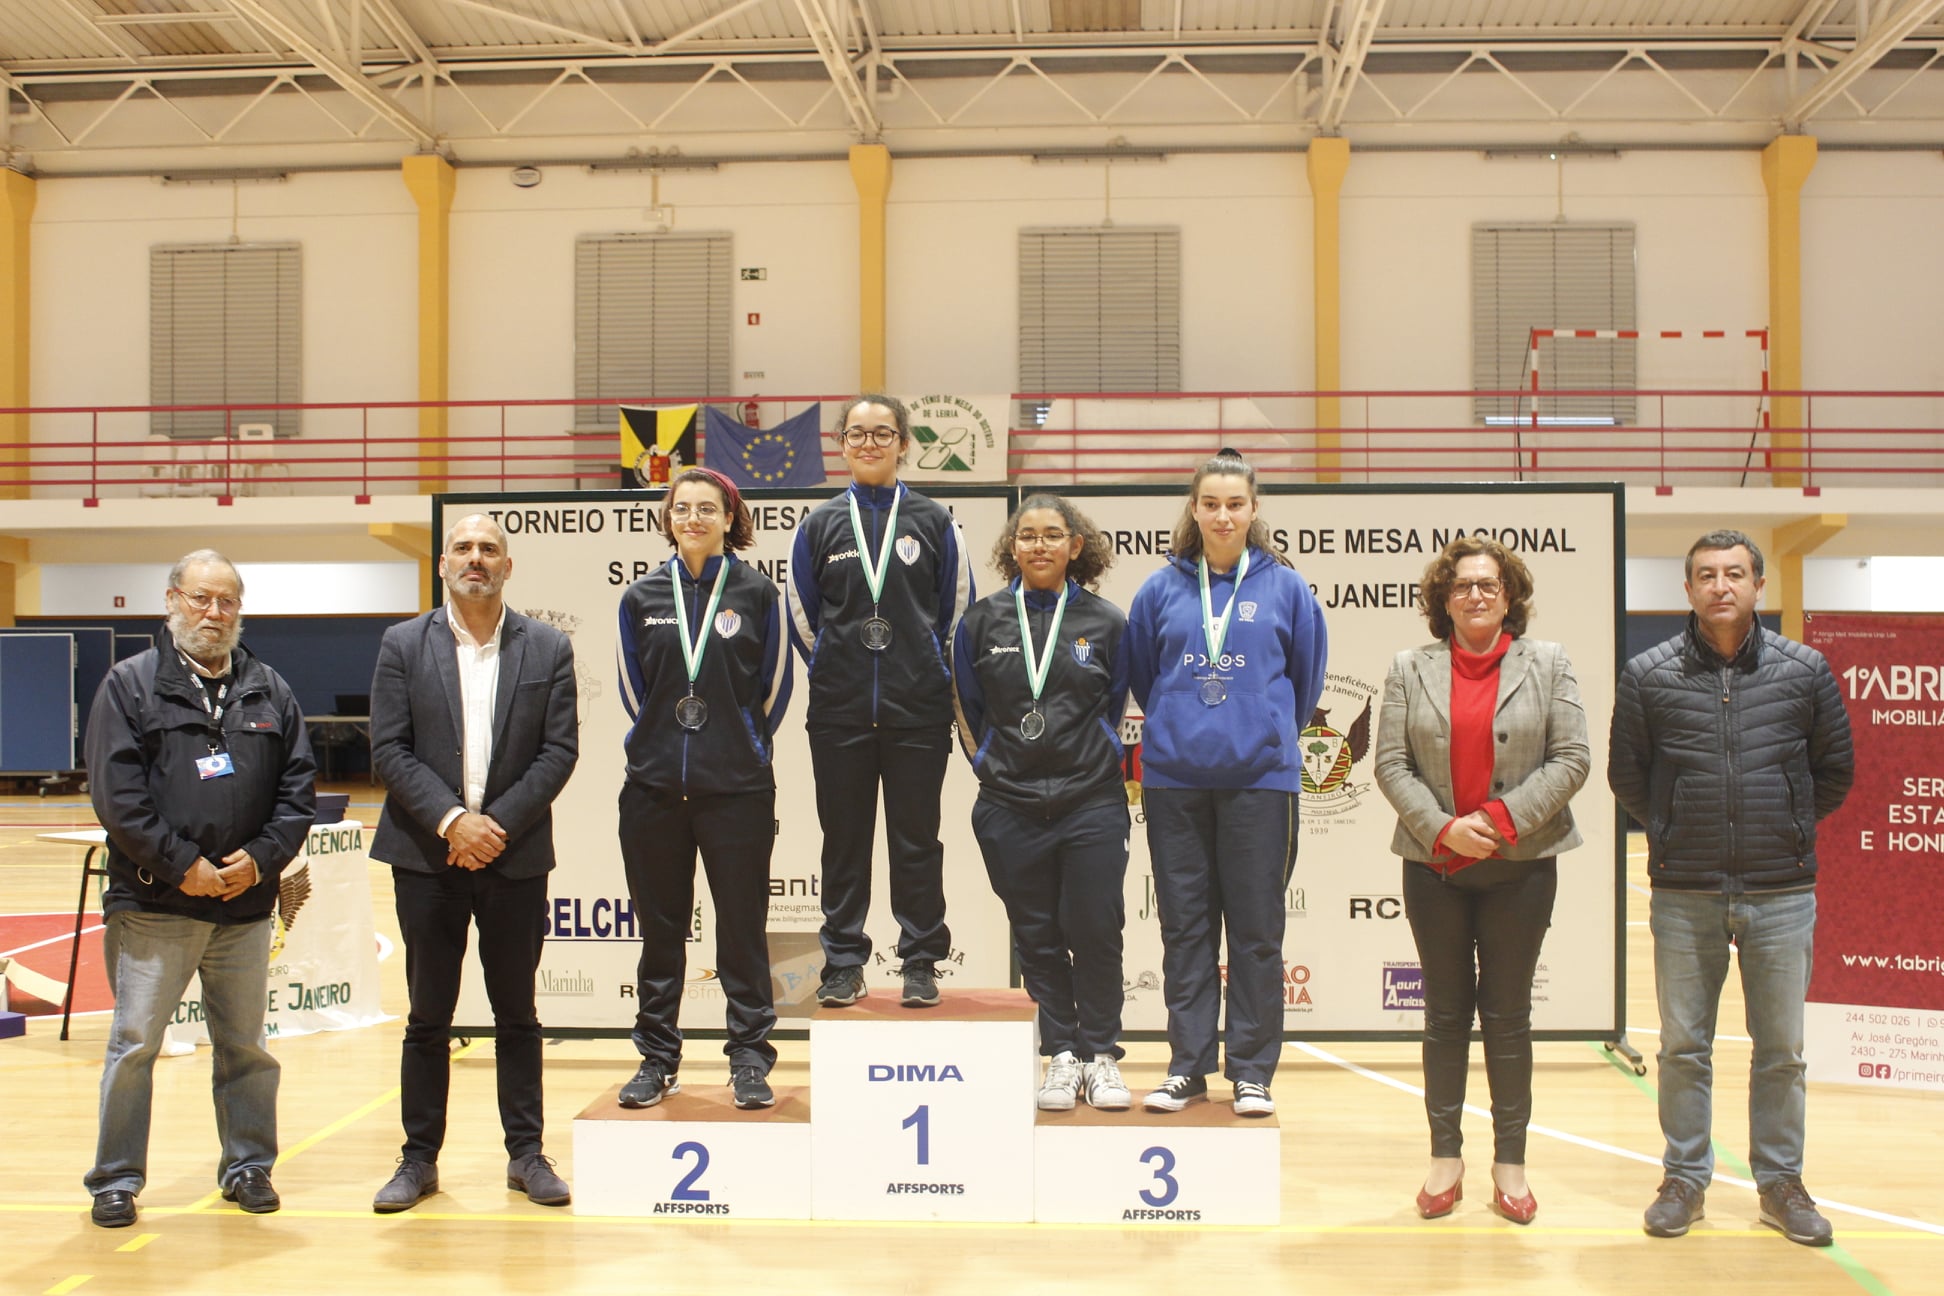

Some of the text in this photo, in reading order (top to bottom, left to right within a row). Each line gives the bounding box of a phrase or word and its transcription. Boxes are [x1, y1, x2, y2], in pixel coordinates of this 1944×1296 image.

[936, 409, 959, 418] LEIRIA
[489, 509, 605, 534] TORNEIO
[613, 503, 664, 532] TÉN
[1299, 529, 1335, 554] DE
[1345, 529, 1423, 553] MESA
[1326, 583, 1424, 608] JANEIR
[1331, 684, 1364, 700] Janeiro
[1903, 777, 1944, 798] SER
[1889, 804, 1944, 825] ESTA
[1310, 827, 1329, 835] 1939
[1861, 831, 1874, 850] E
[306, 827, 362, 857] ICÊNCIA
[1349, 897, 1409, 920] RC
[268, 964, 289, 978] EIRO
[1842, 954, 1944, 976] www.1abrig
[541, 970, 594, 993] Marinha
[1385, 971, 1422, 990] Louri
[288, 982, 351, 1011] JANEIRO
[1845, 1012, 1864, 1023] 244
[1868, 1013, 1887, 1025] 502
[1890, 1015, 1911, 1026] 026
[1868, 1032, 1891, 1043] José
[1851, 1046, 1876, 1057] 2430
[1889, 1048, 1908, 1060] 275
[1910, 1050, 1944, 1062] Marinh
[867, 1064, 965, 1083] DIMA
[902, 1104, 930, 1166] 1
[671, 1141, 711, 1201] 2
[1138, 1145, 1179, 1208] 3
[886, 1182, 966, 1196] AFFSPORTS
[652, 1202, 731, 1216] AFFSPORTS
[1121, 1208, 1202, 1221] AFFSPORTS
